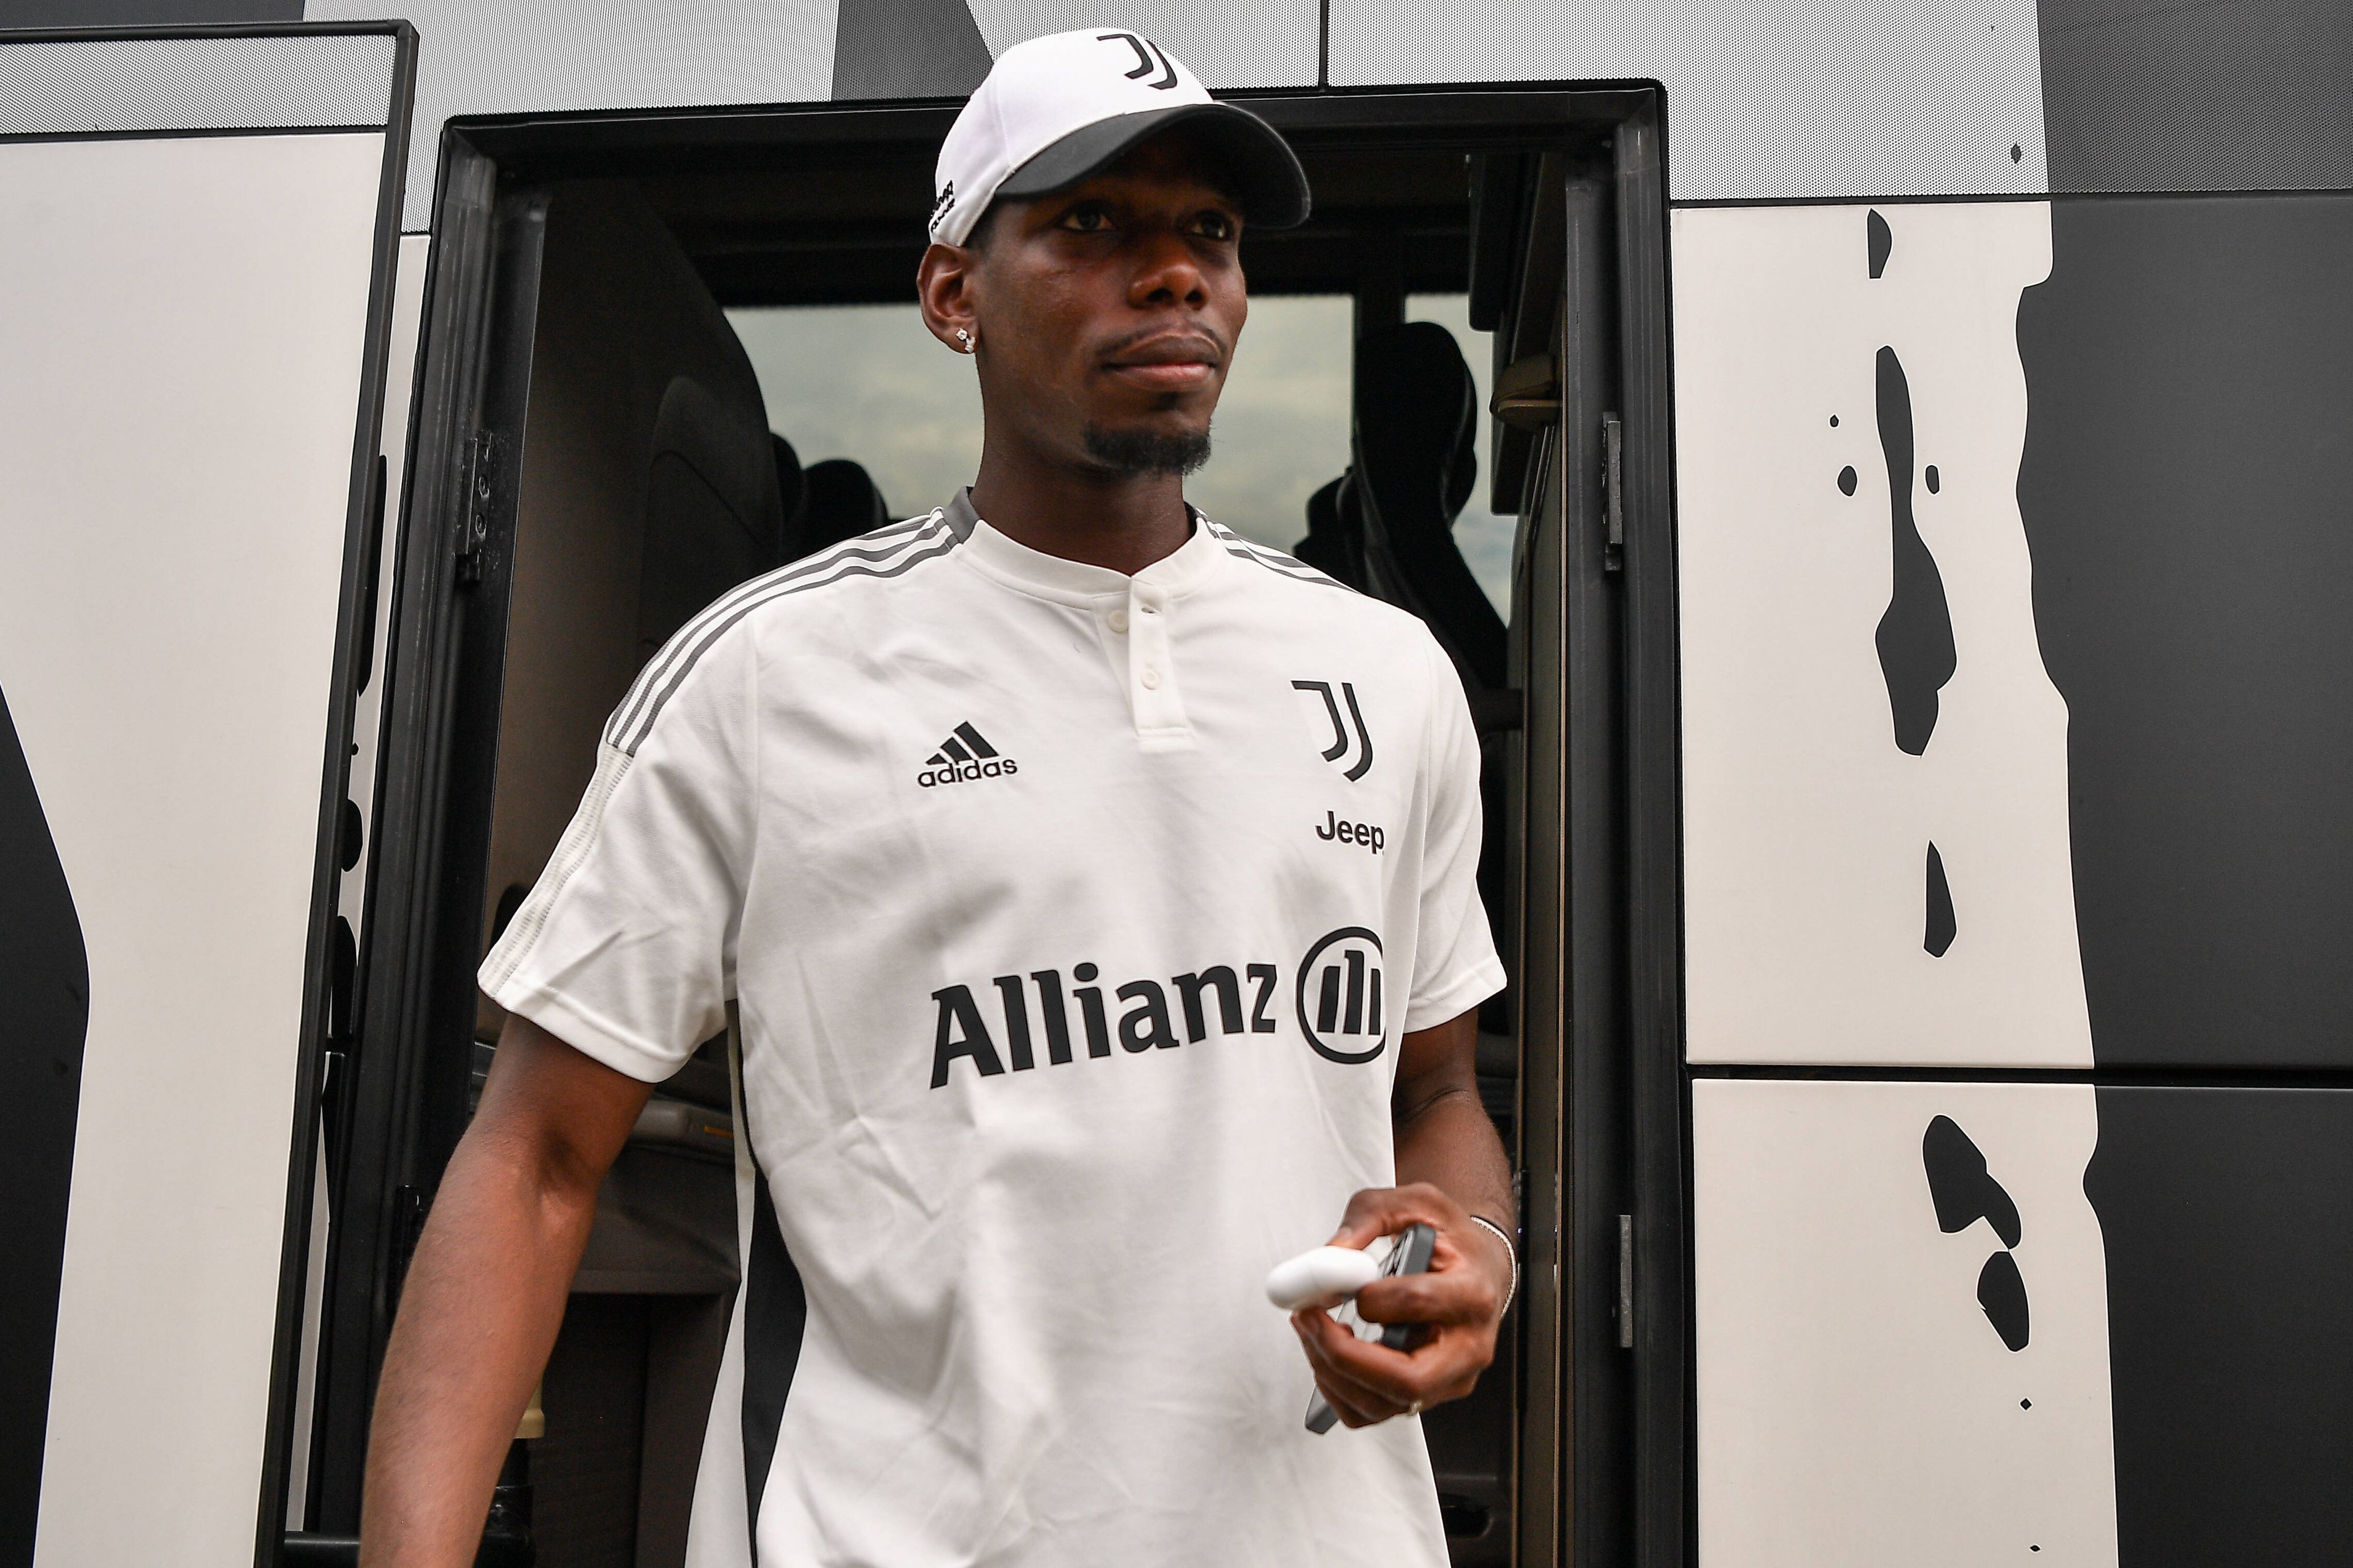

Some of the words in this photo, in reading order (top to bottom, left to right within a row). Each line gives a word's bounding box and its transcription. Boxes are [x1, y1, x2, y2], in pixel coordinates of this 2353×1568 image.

[918, 759, 1018, 788] adidas
[1315, 810, 1384, 855] Jeep
[930, 963, 1277, 1090] Allianz
